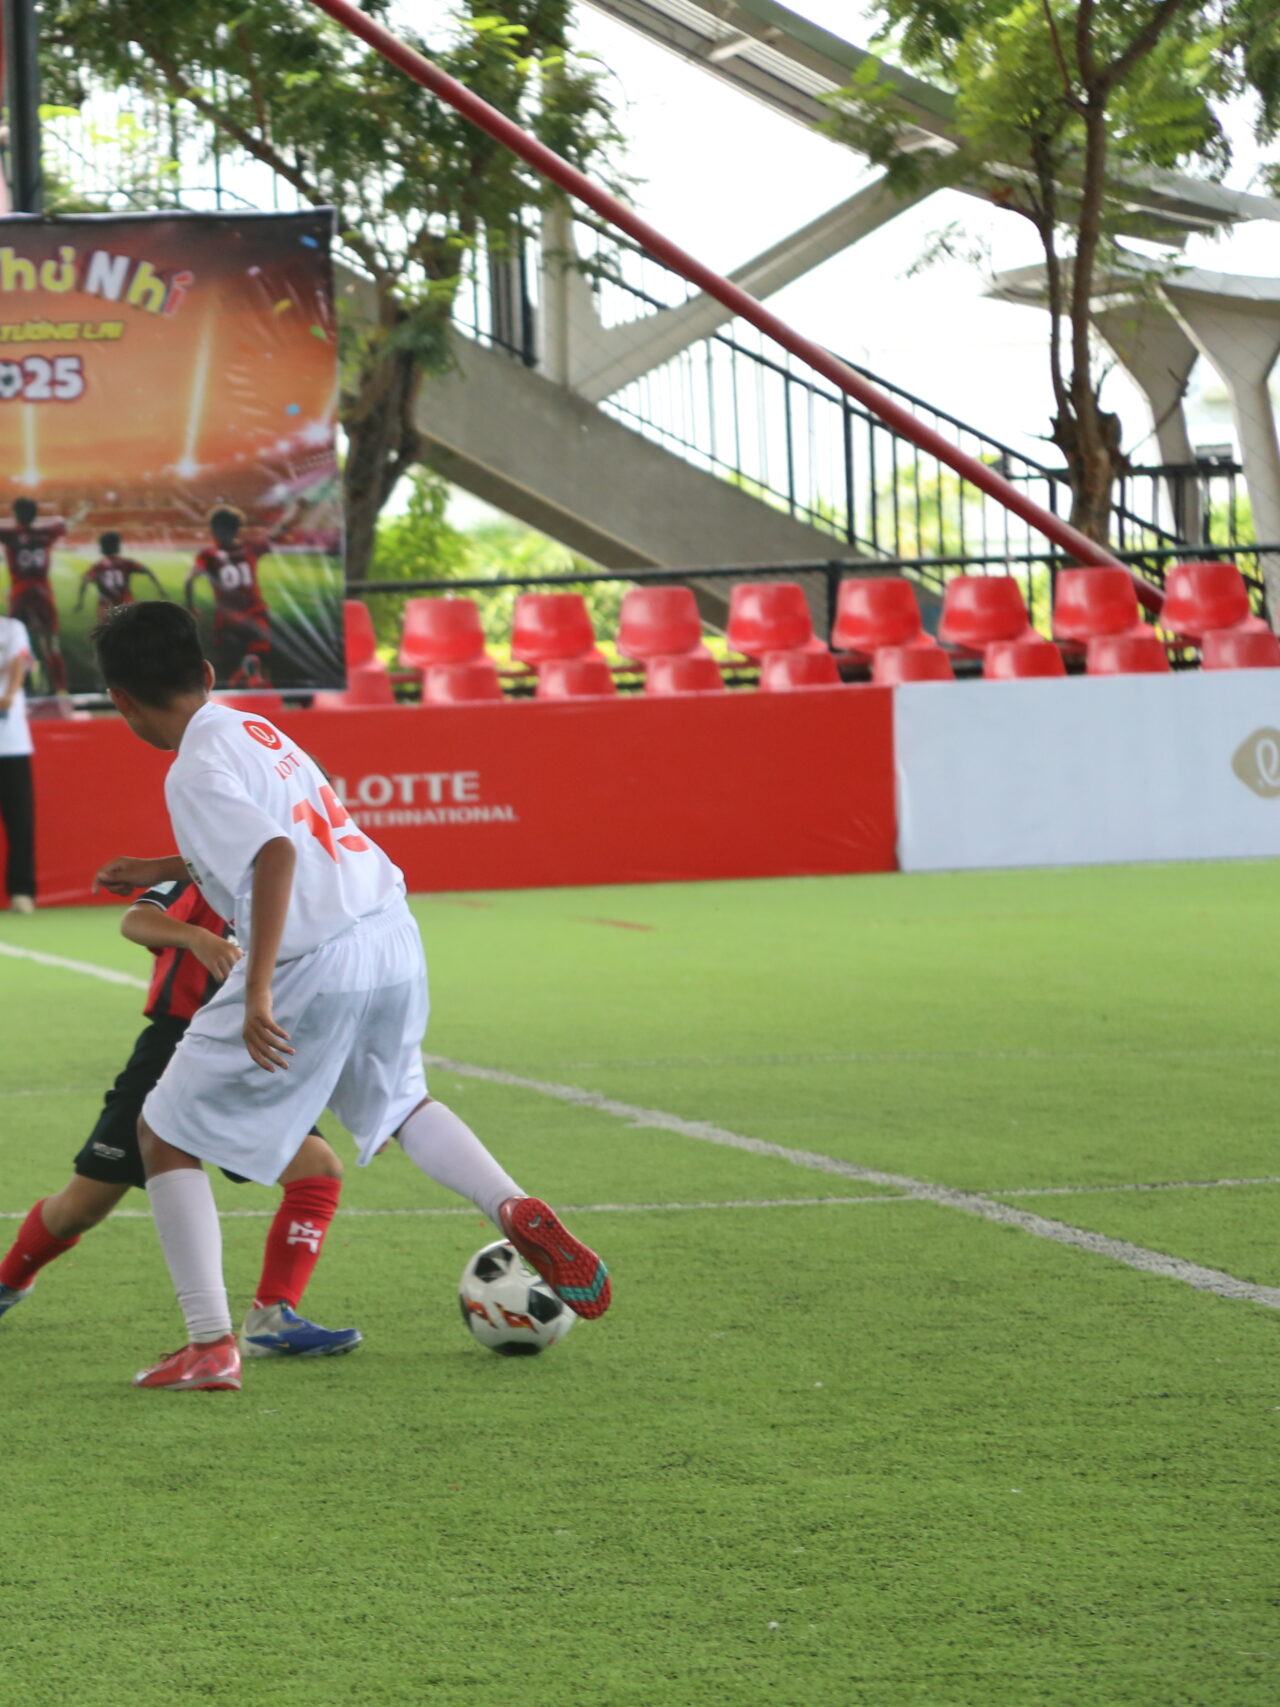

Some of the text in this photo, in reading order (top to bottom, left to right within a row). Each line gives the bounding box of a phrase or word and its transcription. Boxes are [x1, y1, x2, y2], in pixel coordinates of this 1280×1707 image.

[84, 250, 194, 316] Nhí
[219, 561, 253, 589] 01
[335, 771, 480, 807] LOTTE
